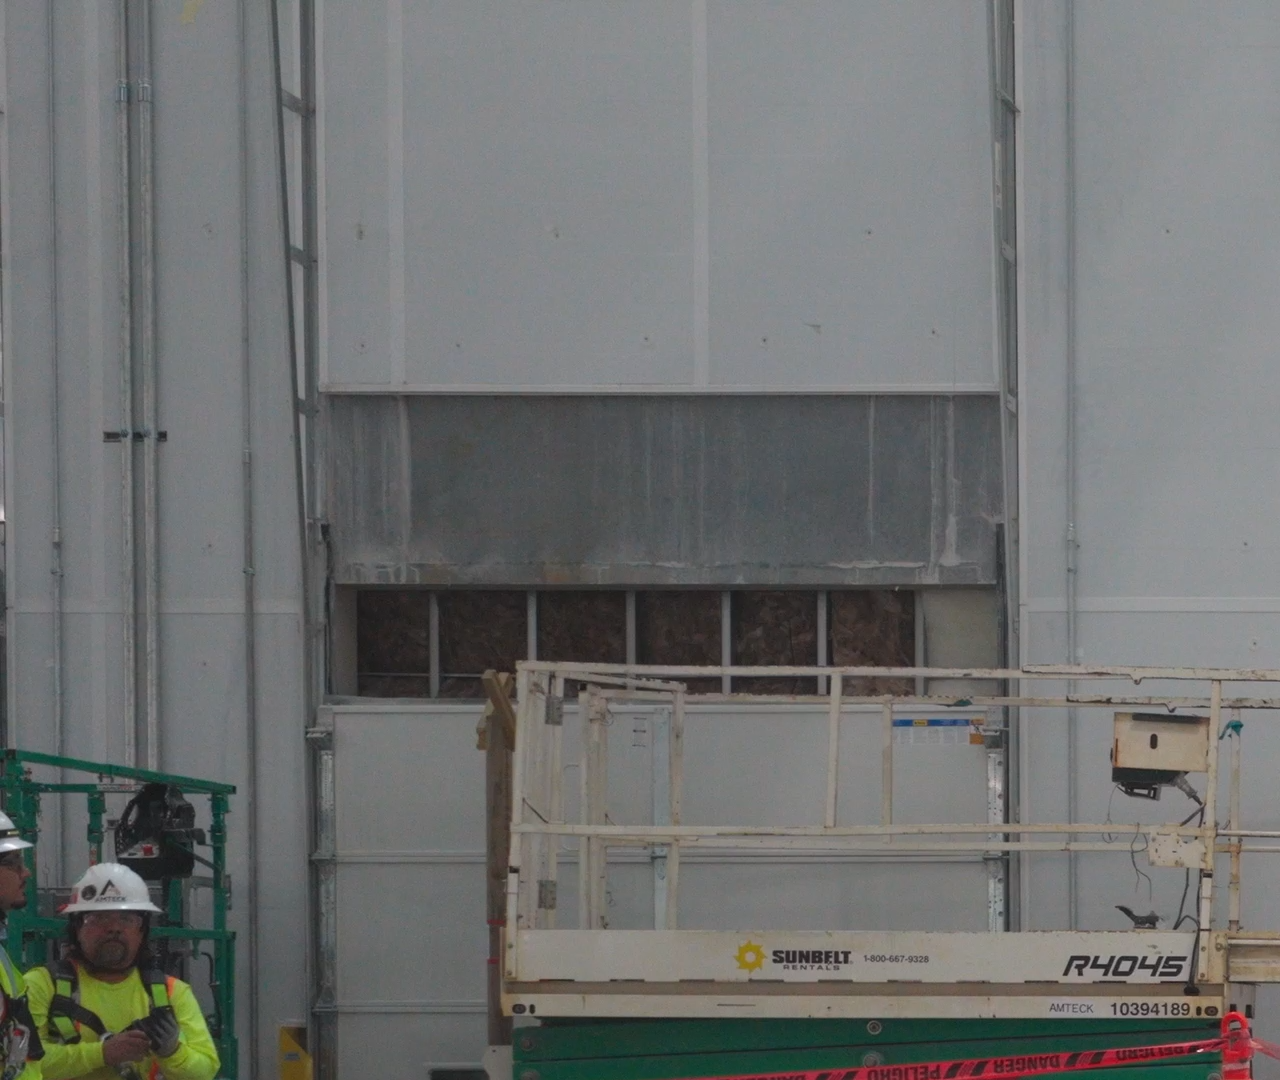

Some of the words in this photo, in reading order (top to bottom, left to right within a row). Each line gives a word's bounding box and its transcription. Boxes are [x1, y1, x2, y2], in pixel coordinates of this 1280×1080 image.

[772, 950, 852, 965] SUNBELT
[863, 955, 930, 964] 1-800-667-9328
[1062, 955, 1188, 977] R4045
[1049, 1003, 1094, 1014] AMTECK
[1110, 1002, 1191, 1017] 10394189
[993, 1054, 1061, 1074] DANGER
